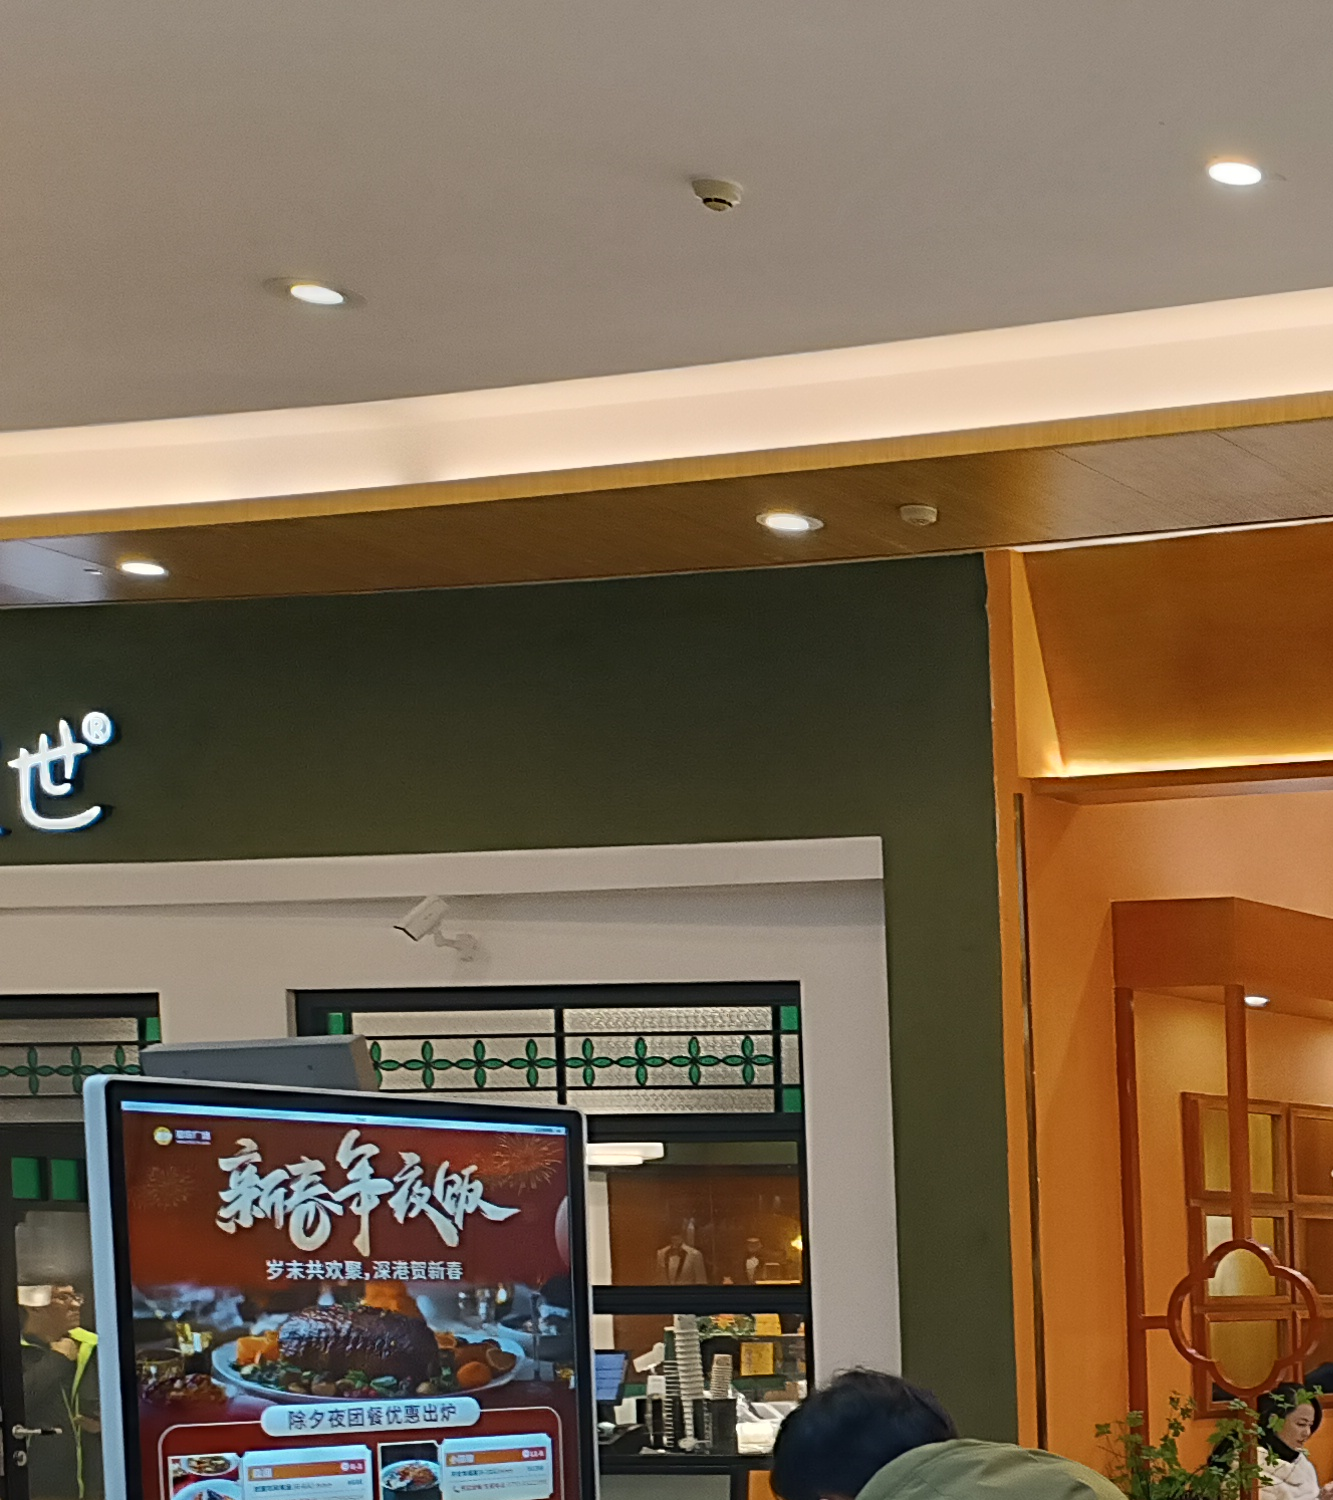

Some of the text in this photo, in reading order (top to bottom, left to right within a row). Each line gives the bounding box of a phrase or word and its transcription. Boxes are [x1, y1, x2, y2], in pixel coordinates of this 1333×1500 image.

[266, 1259, 463, 1281] 岁末共欢聚,深港贺新春
[288, 1404, 457, 1429] 除夕夜团餐优惠出炉
